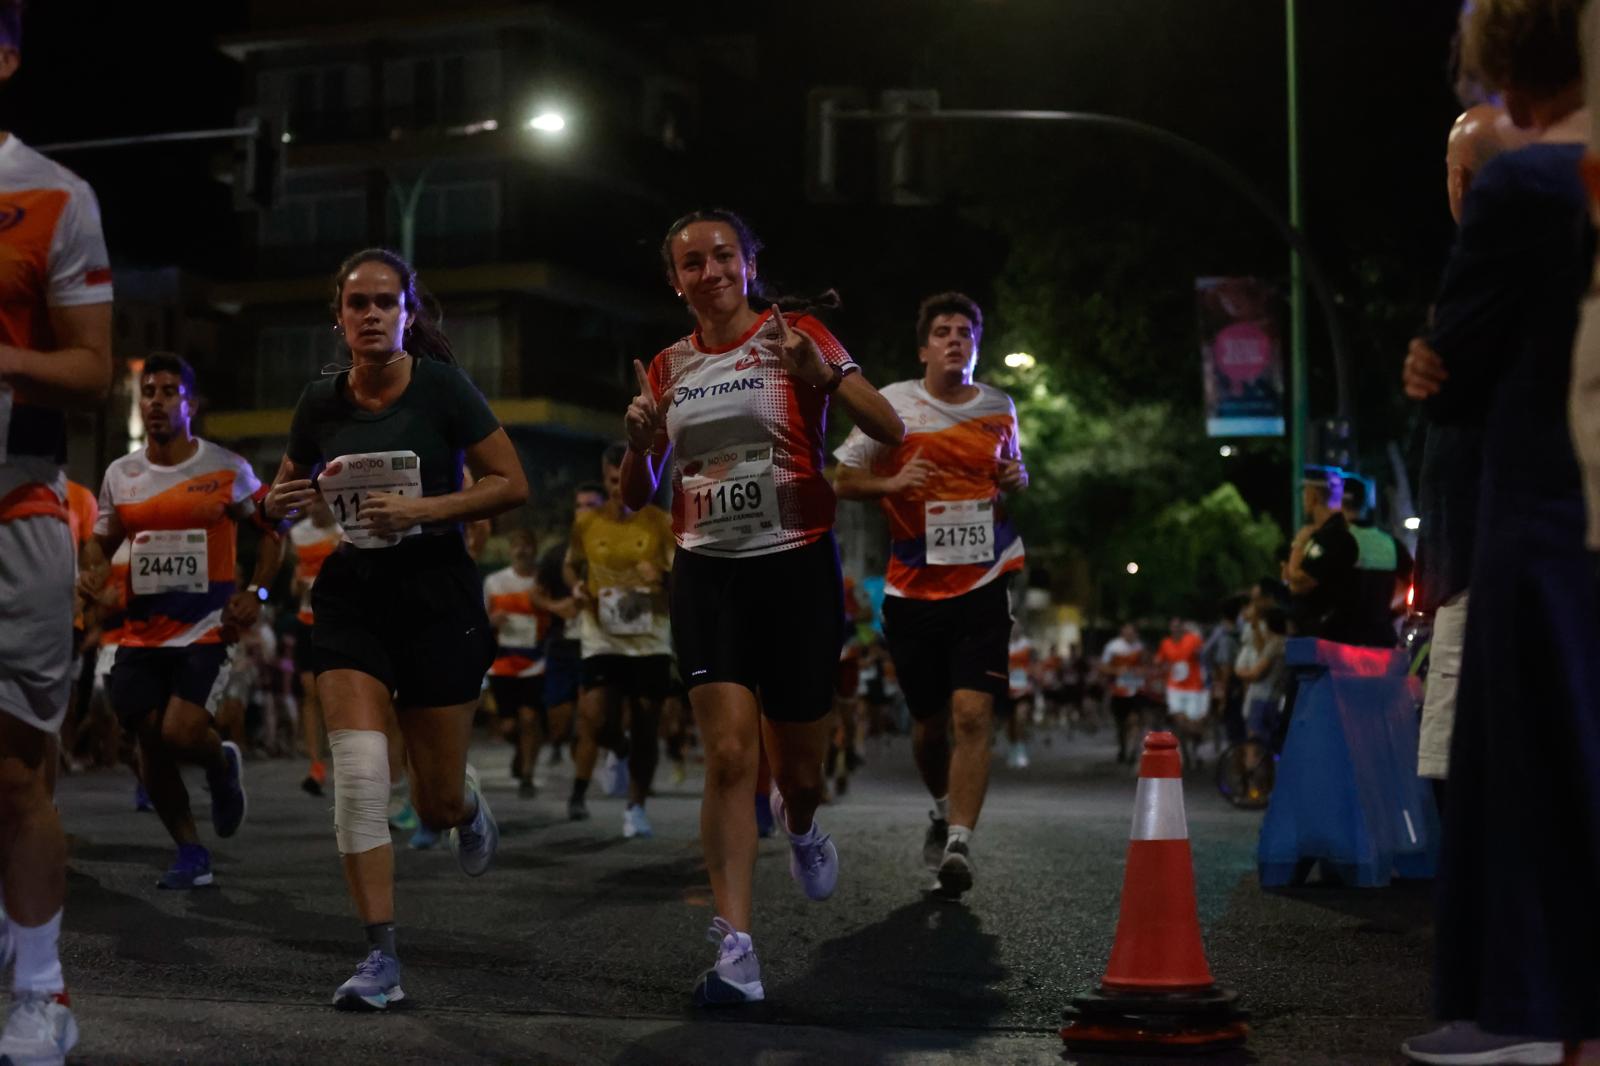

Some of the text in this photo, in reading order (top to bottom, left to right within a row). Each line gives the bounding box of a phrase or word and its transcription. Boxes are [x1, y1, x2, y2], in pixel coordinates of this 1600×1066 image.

[694, 481, 762, 519] 11169
[934, 525, 986, 547] 21753
[139, 556, 197, 576] 24479
